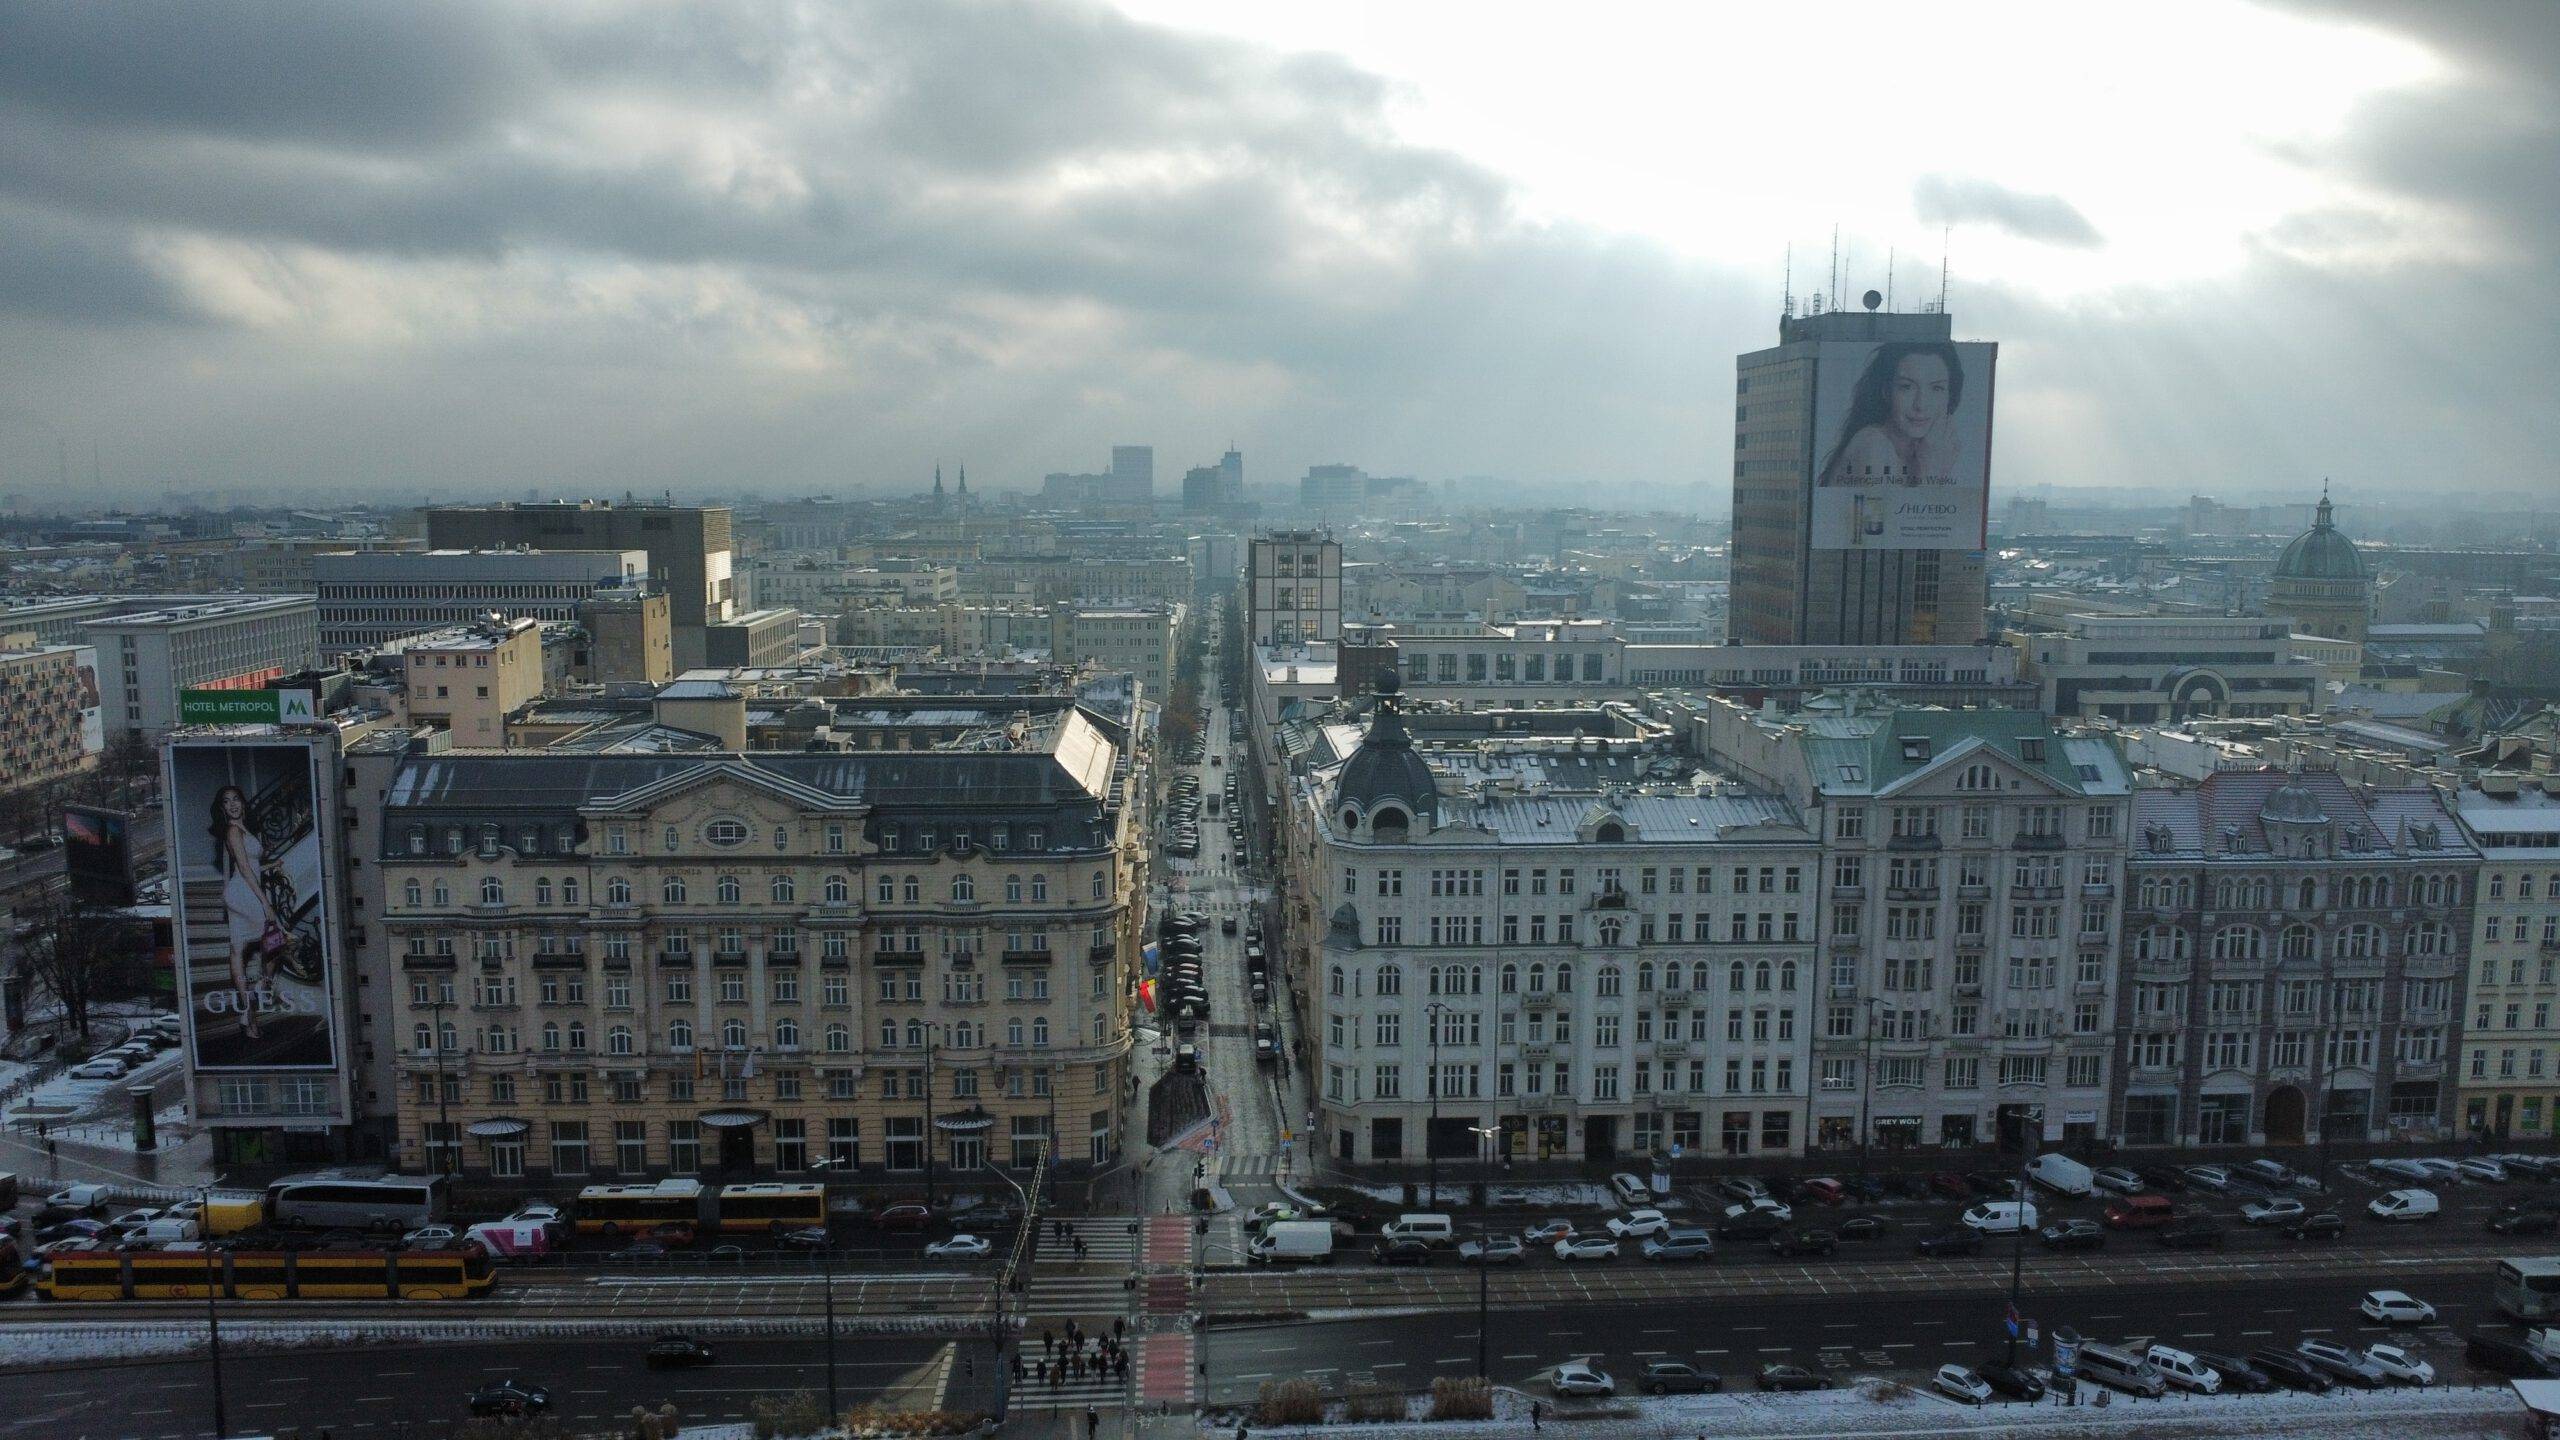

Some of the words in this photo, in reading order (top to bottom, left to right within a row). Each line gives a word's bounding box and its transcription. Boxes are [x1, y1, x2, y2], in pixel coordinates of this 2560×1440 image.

[1895, 502, 1958, 515] SHISEIDO
[184, 702, 217, 712] HOTEL
[219, 702, 275, 712] METROPOL
[203, 990, 318, 1014] GUESS
[1875, 1118, 1897, 1126] GREY
